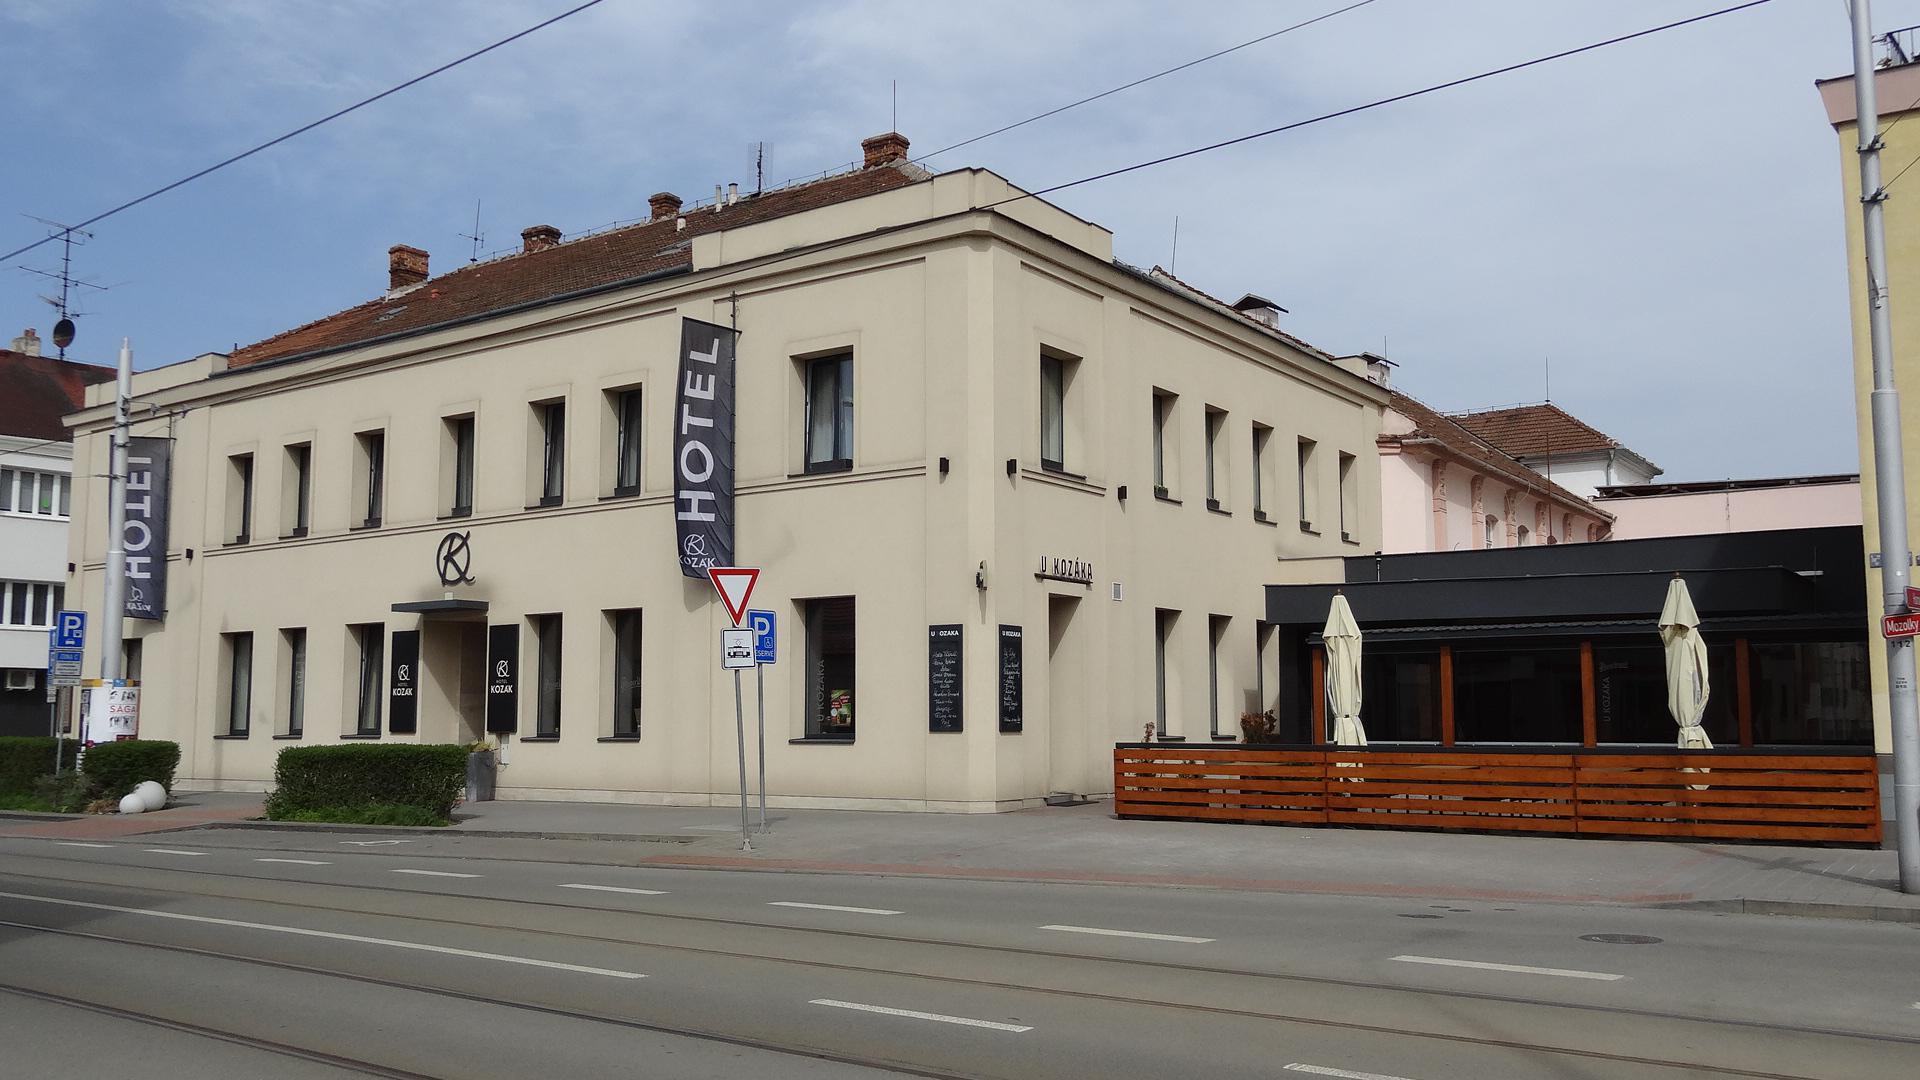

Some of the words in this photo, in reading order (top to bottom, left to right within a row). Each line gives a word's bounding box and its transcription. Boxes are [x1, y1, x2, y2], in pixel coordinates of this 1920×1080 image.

[677, 337, 720, 523] HOTEL
[1041, 555, 1047, 573] U
[1053, 556, 1093, 580] KOZÁKA
[63, 616, 81, 637] P
[754, 617, 770, 646] P
[1886, 619, 1919, 634] Mozolky
[109, 705, 136, 713] SAGA
